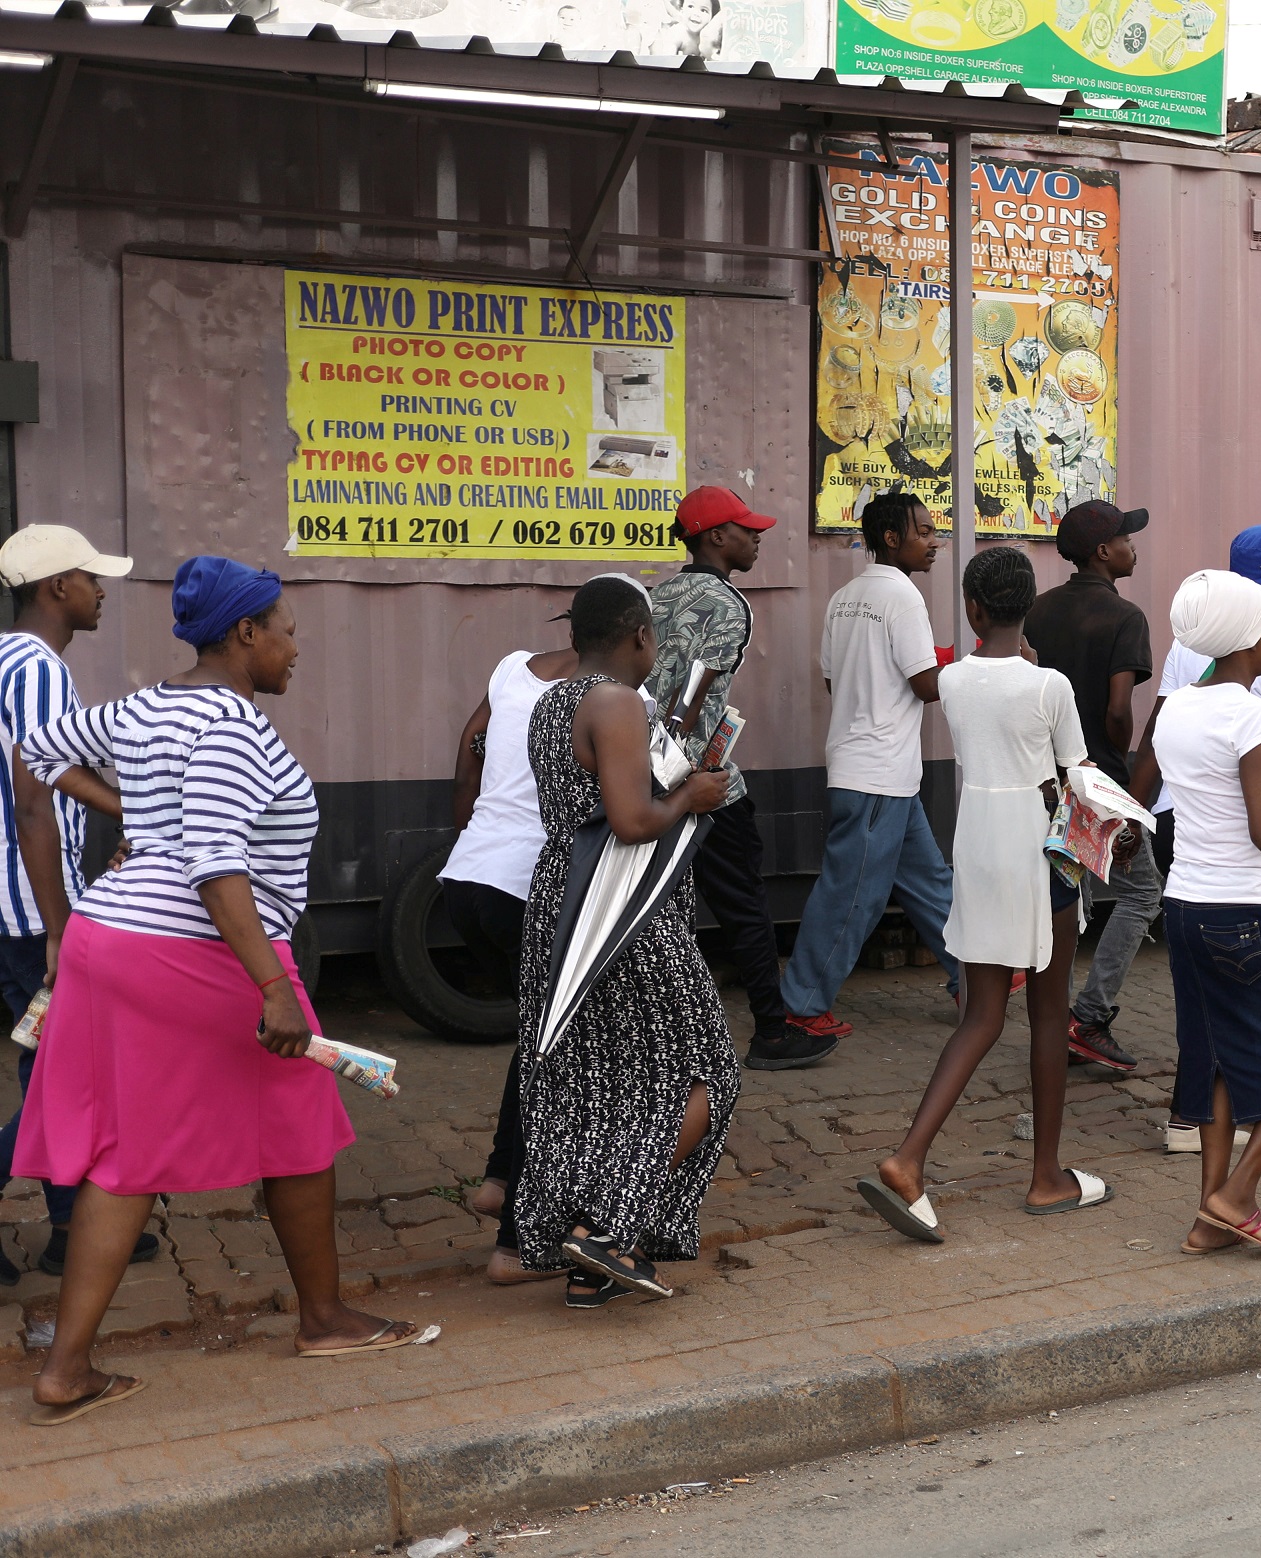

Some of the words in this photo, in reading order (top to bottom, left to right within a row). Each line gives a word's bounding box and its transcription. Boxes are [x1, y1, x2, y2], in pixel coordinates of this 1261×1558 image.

[854, 44, 879, 55] SHOP
[881, 48, 902, 59] NO:6
[904, 51, 932, 62] INSIDE
[934, 55, 965, 66] BOXER
[966, 58, 1024, 74] SUPERSTORE
[856, 60, 884, 72] PLAZA
[933, 69, 971, 82] GARAGE
[1052, 73, 1075, 84] SHOP
[1076, 77, 1096, 87] NO:6
[1097, 80, 1124, 91] INSIDE
[1125, 83, 1153, 95] BOXER
[1154, 87, 1207, 102] SUPERSTORE
[1131, 112, 1147, 123] 711
[1149, 114, 1171, 126] 2704
[1160, 101, 1207, 116] ALEXANDRA
[859, 149, 1081, 200] NAWO
[831, 183, 937, 211] GOLD
[994, 200, 1107, 229] COINS
[838, 230, 868, 243] HOP
[901, 236, 909, 248] 6
[913, 237, 950, 251] INSID
[971, 242, 1006, 257] OXER
[861, 244, 904, 259] PLAZA
[991, 257, 1043, 273] GARAGE
[982, 270, 1031, 290] 711
[1040, 276, 1107, 298] 2705
[298, 280, 416, 329] NAZWO
[428, 289, 528, 335] PRINT
[539, 297, 674, 344] EXPRESS
[352, 335, 445, 359] PHOTO
[448, 341, 527, 363] COPY
[319, 363, 404, 385] BLACK
[412, 367, 450, 387] OR
[458, 370, 549, 391] COLOR
[380, 394, 483, 417] PRINTING
[490, 399, 517, 418] CV
[323, 420, 384, 440] FROM
[393, 424, 467, 444] PHONE
[475, 427, 504, 445] OR
[512, 428, 554, 446] USB
[302, 449, 388, 474] TYPING
[395, 452, 431, 475] CV
[437, 454, 473, 476] OR
[481, 455, 575, 478] EDITING
[841, 462, 859, 473] WE
[863, 463, 886, 474] BUY
[293, 479, 408, 507] LAMINATING
[414, 483, 451, 507] AND
[458, 483, 549, 510] CREATING
[555, 485, 608, 511] EMAIL
[829, 476, 861, 487] SUCH
[866, 477, 880, 488] AS
[297, 515, 349, 542] 084
[358, 516, 398, 543] 711
[409, 517, 470, 544] 2701
[513, 520, 561, 545] 062
[570, 521, 614, 546] 679
[863, 612, 882, 622] STARS
